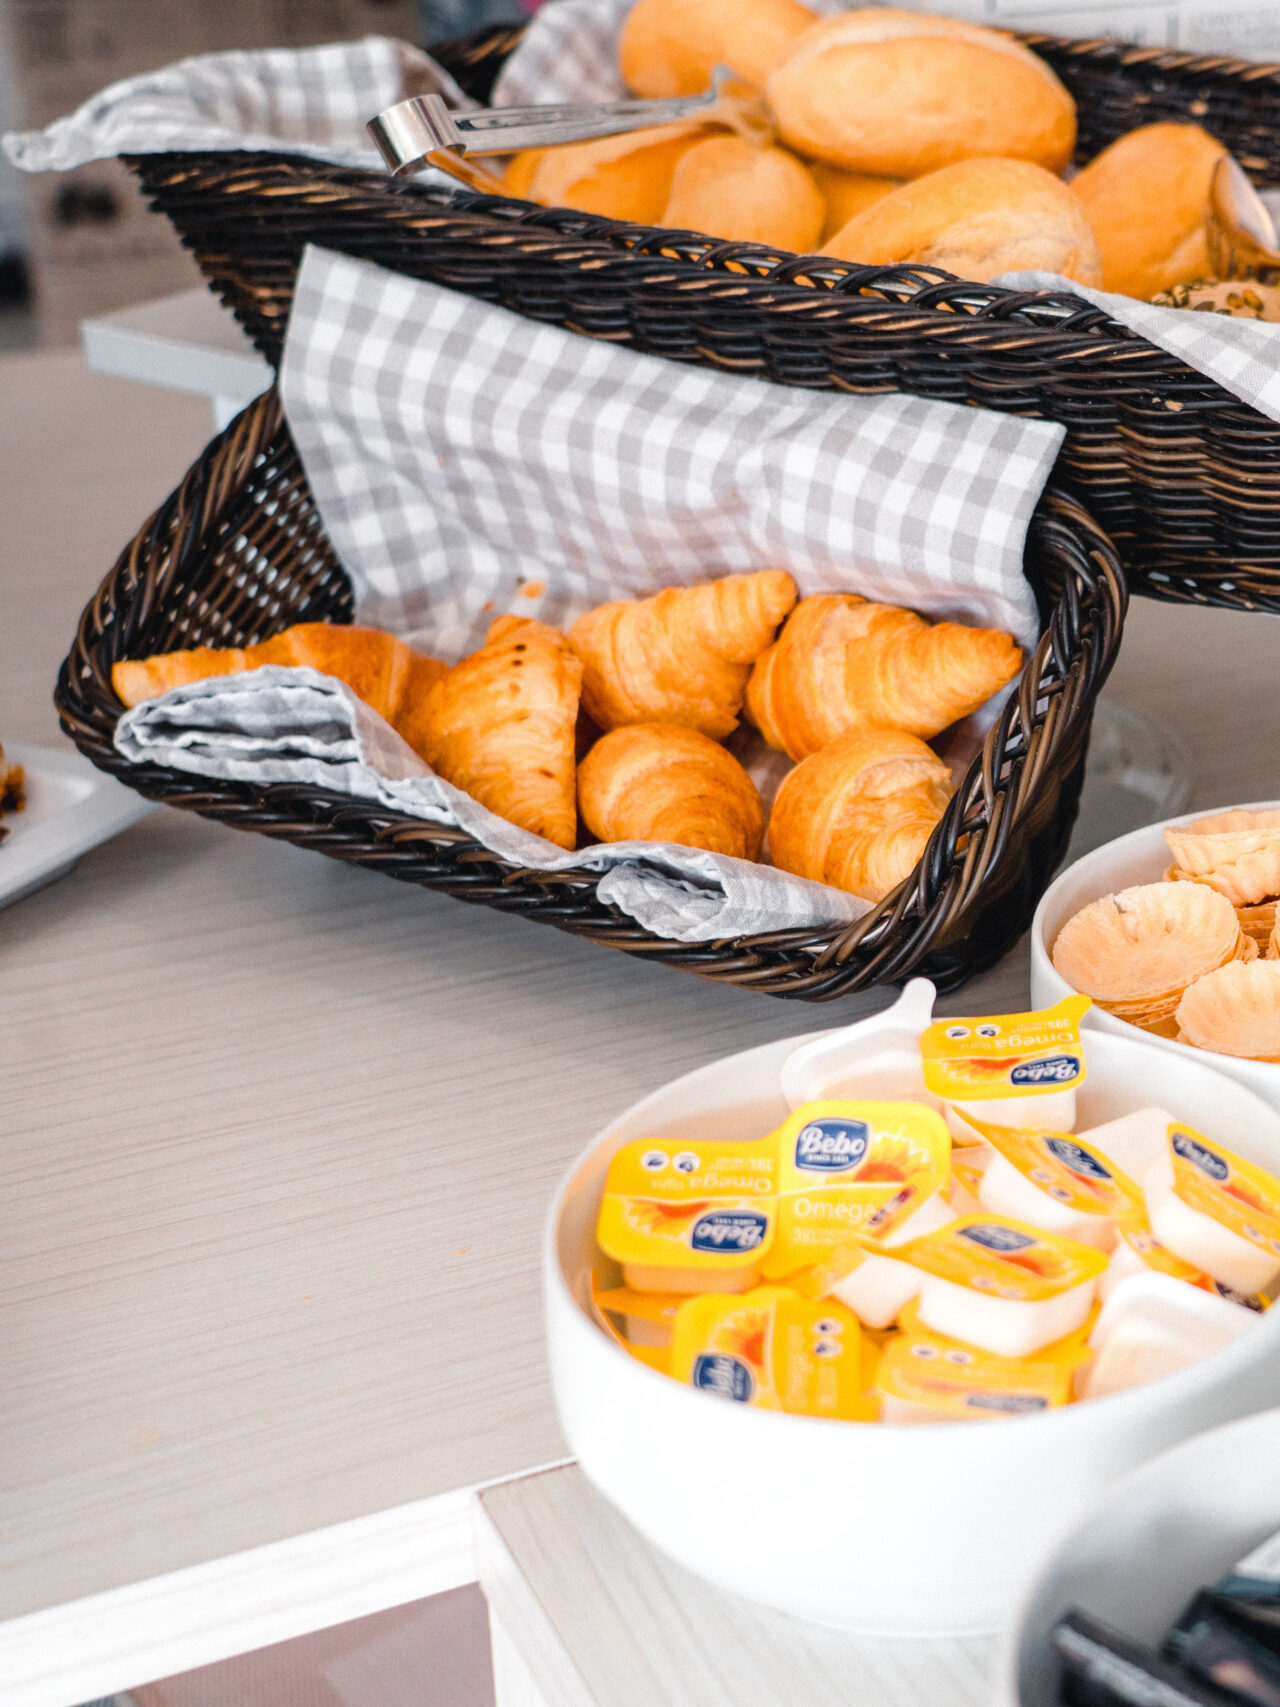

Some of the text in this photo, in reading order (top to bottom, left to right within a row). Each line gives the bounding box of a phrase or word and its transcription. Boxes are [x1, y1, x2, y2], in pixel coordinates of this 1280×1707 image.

[994, 1031, 1074, 1049] Omega
[799, 1126, 865, 1155] Bebo
[689, 1173, 772, 1193] Omega
[694, 1223, 764, 1249] Bebo
